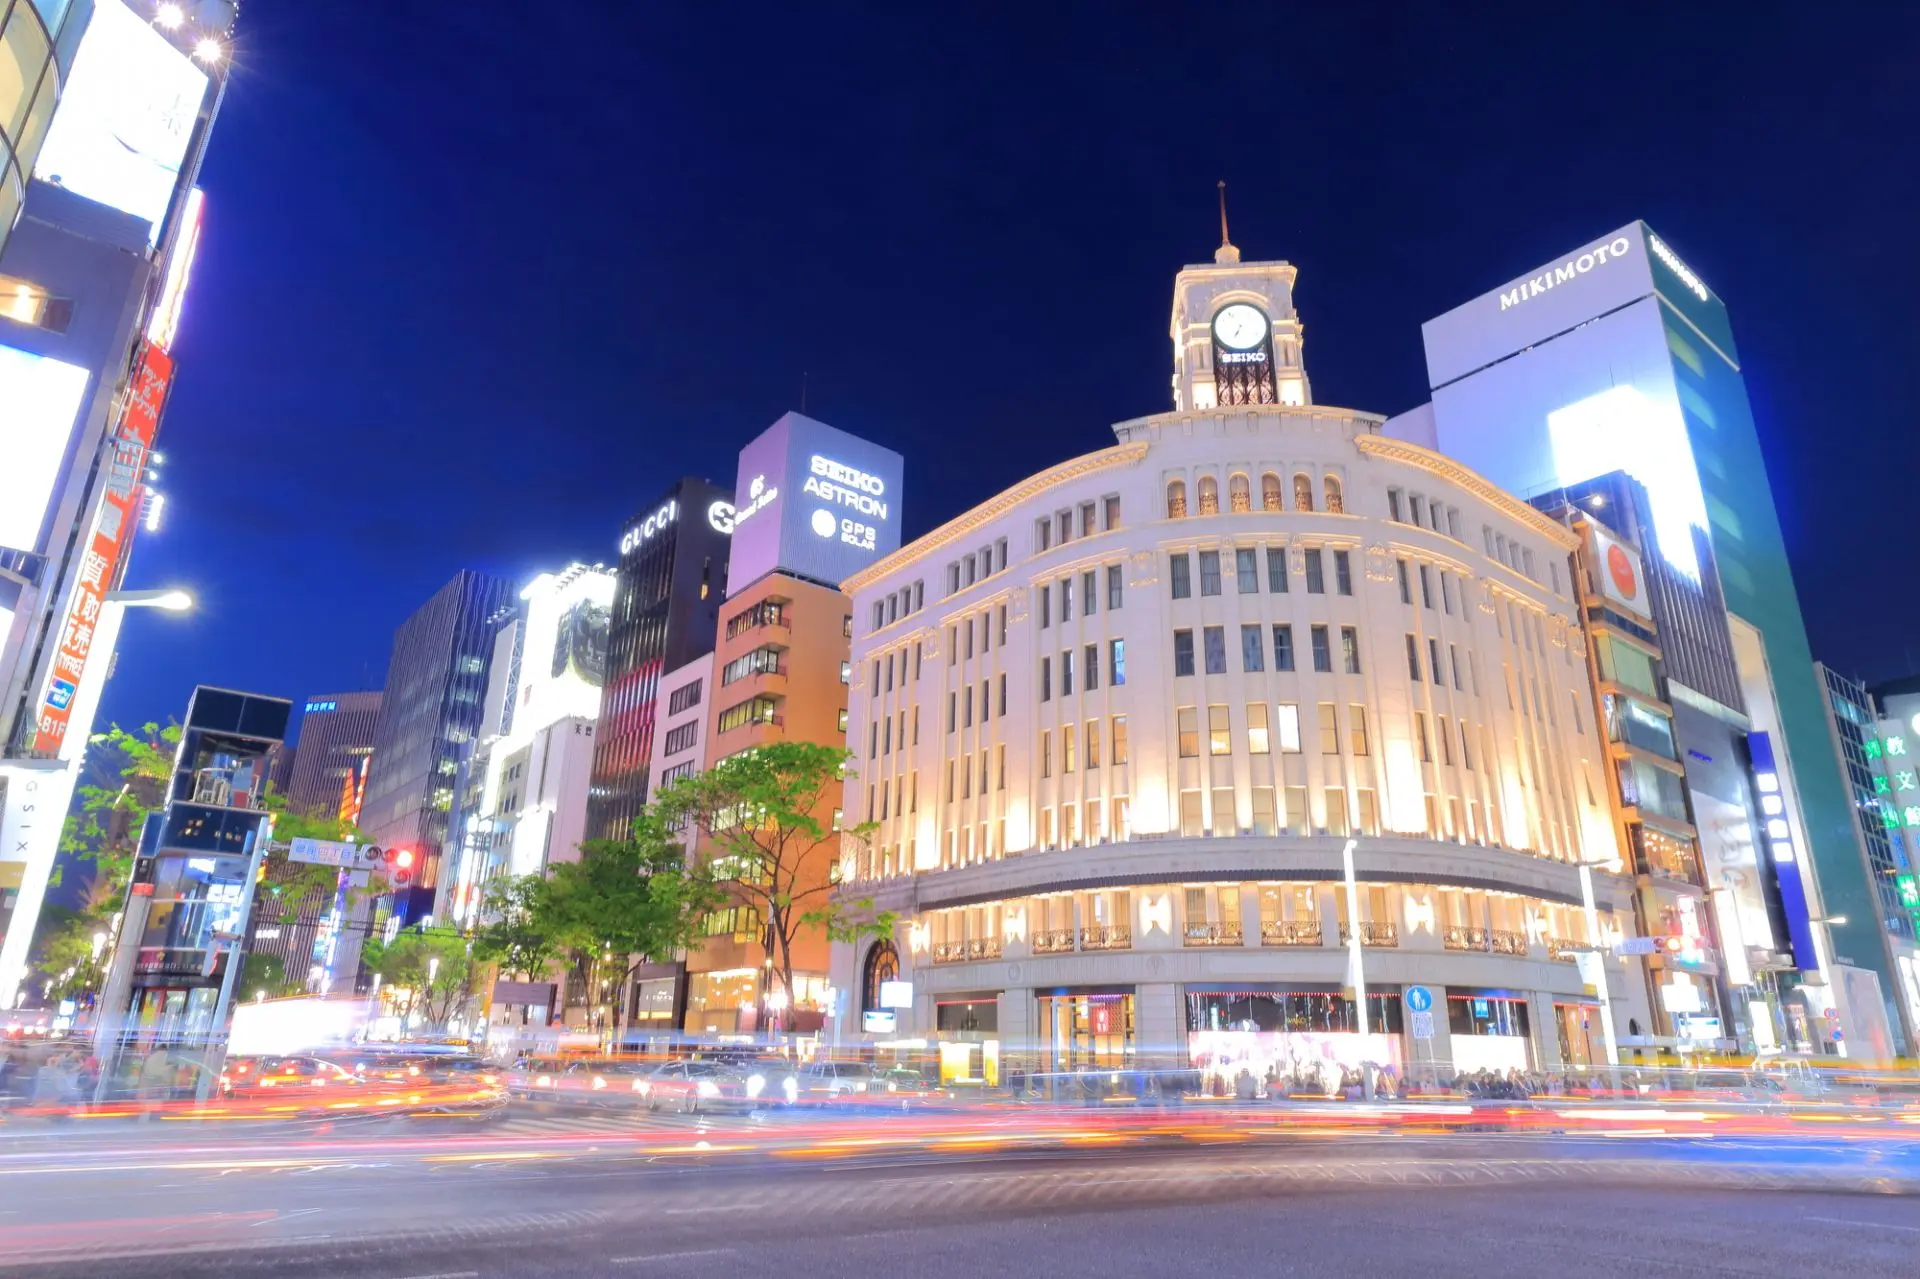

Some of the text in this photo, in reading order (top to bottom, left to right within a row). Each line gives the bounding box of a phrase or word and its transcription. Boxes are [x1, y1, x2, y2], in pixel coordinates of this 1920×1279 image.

[1499, 237, 1630, 311] MIKIMOTO
[1222, 352, 1266, 363] SEIKO
[811, 454, 884, 496] SEIKO
[803, 476, 887, 520] ASTRON
[621, 500, 677, 554] GUCCI
[841, 518, 876, 541] GPS
[841, 532, 876, 552] SOLAR
